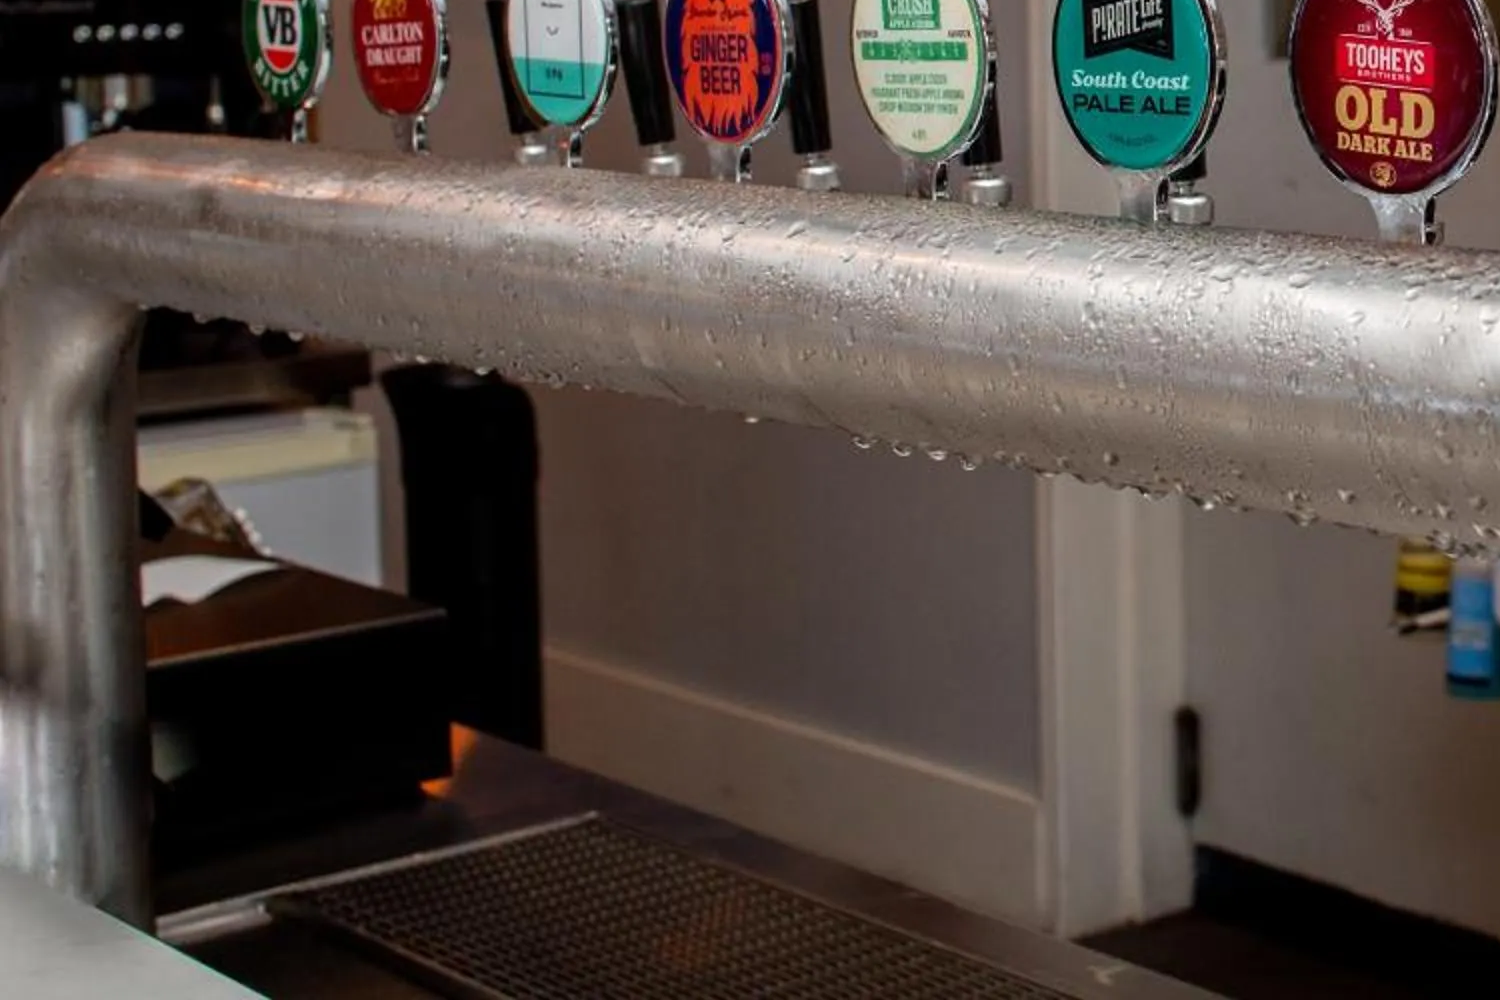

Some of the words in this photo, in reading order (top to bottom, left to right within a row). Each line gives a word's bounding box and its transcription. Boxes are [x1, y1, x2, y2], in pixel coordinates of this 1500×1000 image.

[262, 4, 297, 45] VB
[361, 21, 424, 46] CARLTON
[366, 46, 423, 66] DRAUGHT
[690, 33, 748, 63] GINGER
[1345, 42, 1425, 75] TOOHEYS
[255, 58, 309, 97] BITTER
[701, 66, 741, 95] BEER
[1072, 69, 1127, 88] South
[1132, 69, 1190, 90] Coast
[1072, 93, 1135, 114] PALE
[1140, 95, 1191, 115] ALE
[1335, 85, 1435, 139] OLD
[1337, 131, 1393, 156] DARK
[1393, 139, 1433, 161] ALE
